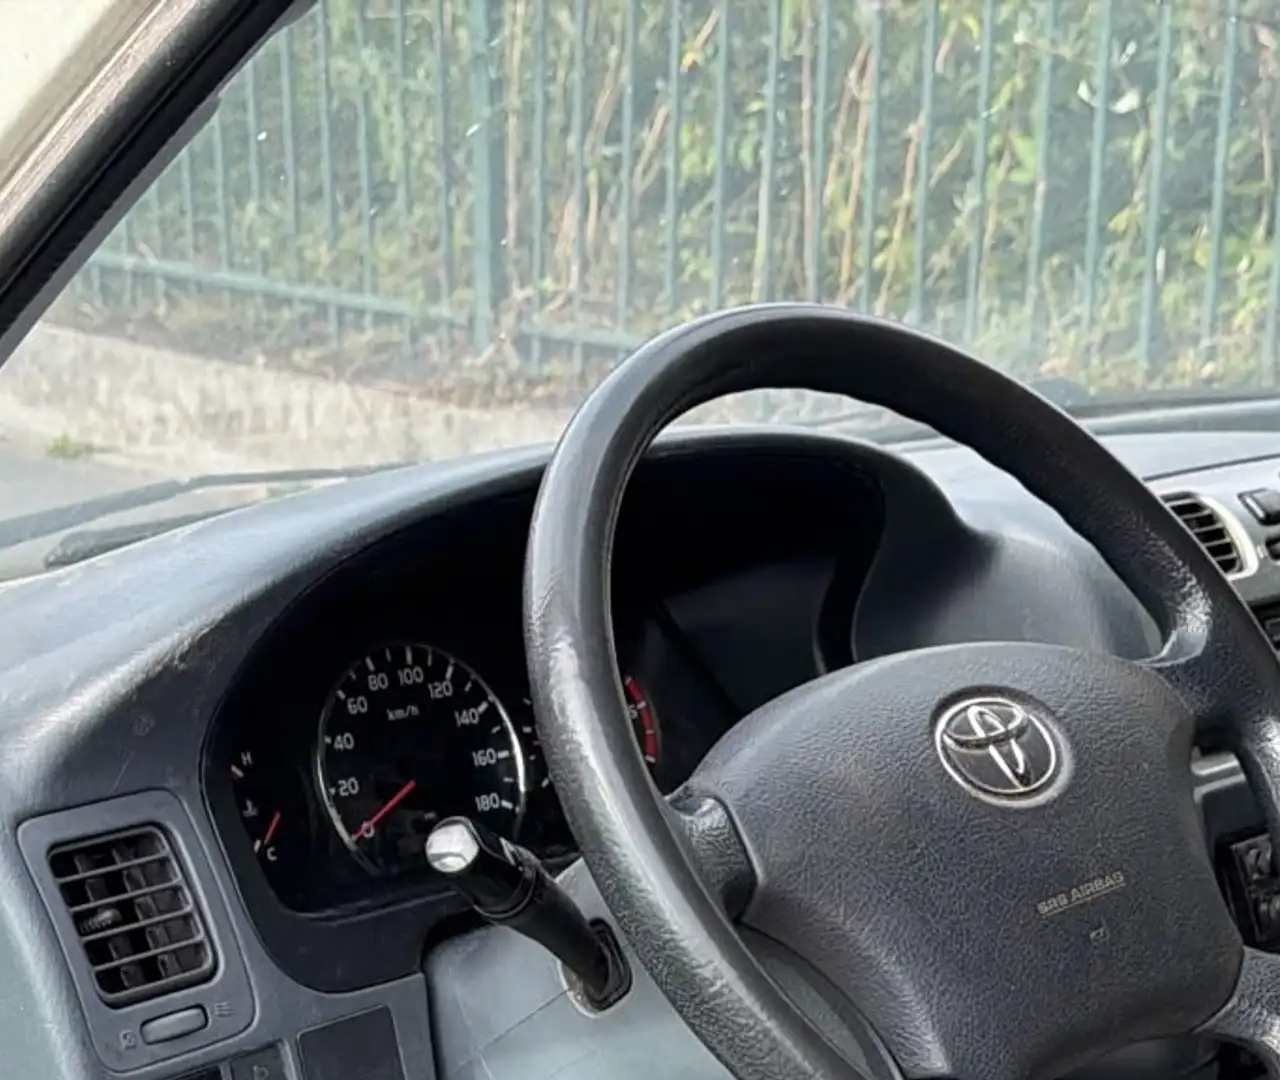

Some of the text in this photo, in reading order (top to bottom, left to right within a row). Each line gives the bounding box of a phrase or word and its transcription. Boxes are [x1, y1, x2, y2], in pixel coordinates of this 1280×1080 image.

[368, 673, 388, 690] 80
[398, 667, 424, 685] 100
[428, 681, 453, 699] 120
[347, 697, 368, 715] 60
[386, 705, 419, 721] km/h
[455, 708, 479, 727] 140
[334, 733, 355, 751] 40
[240, 751, 252, 766] H
[472, 748, 496, 767] 160
[338, 777, 359, 796] 20
[475, 794, 500, 812] 180
[267, 846, 278, 861] C
[1071, 871, 1124, 902] AIRBAG
